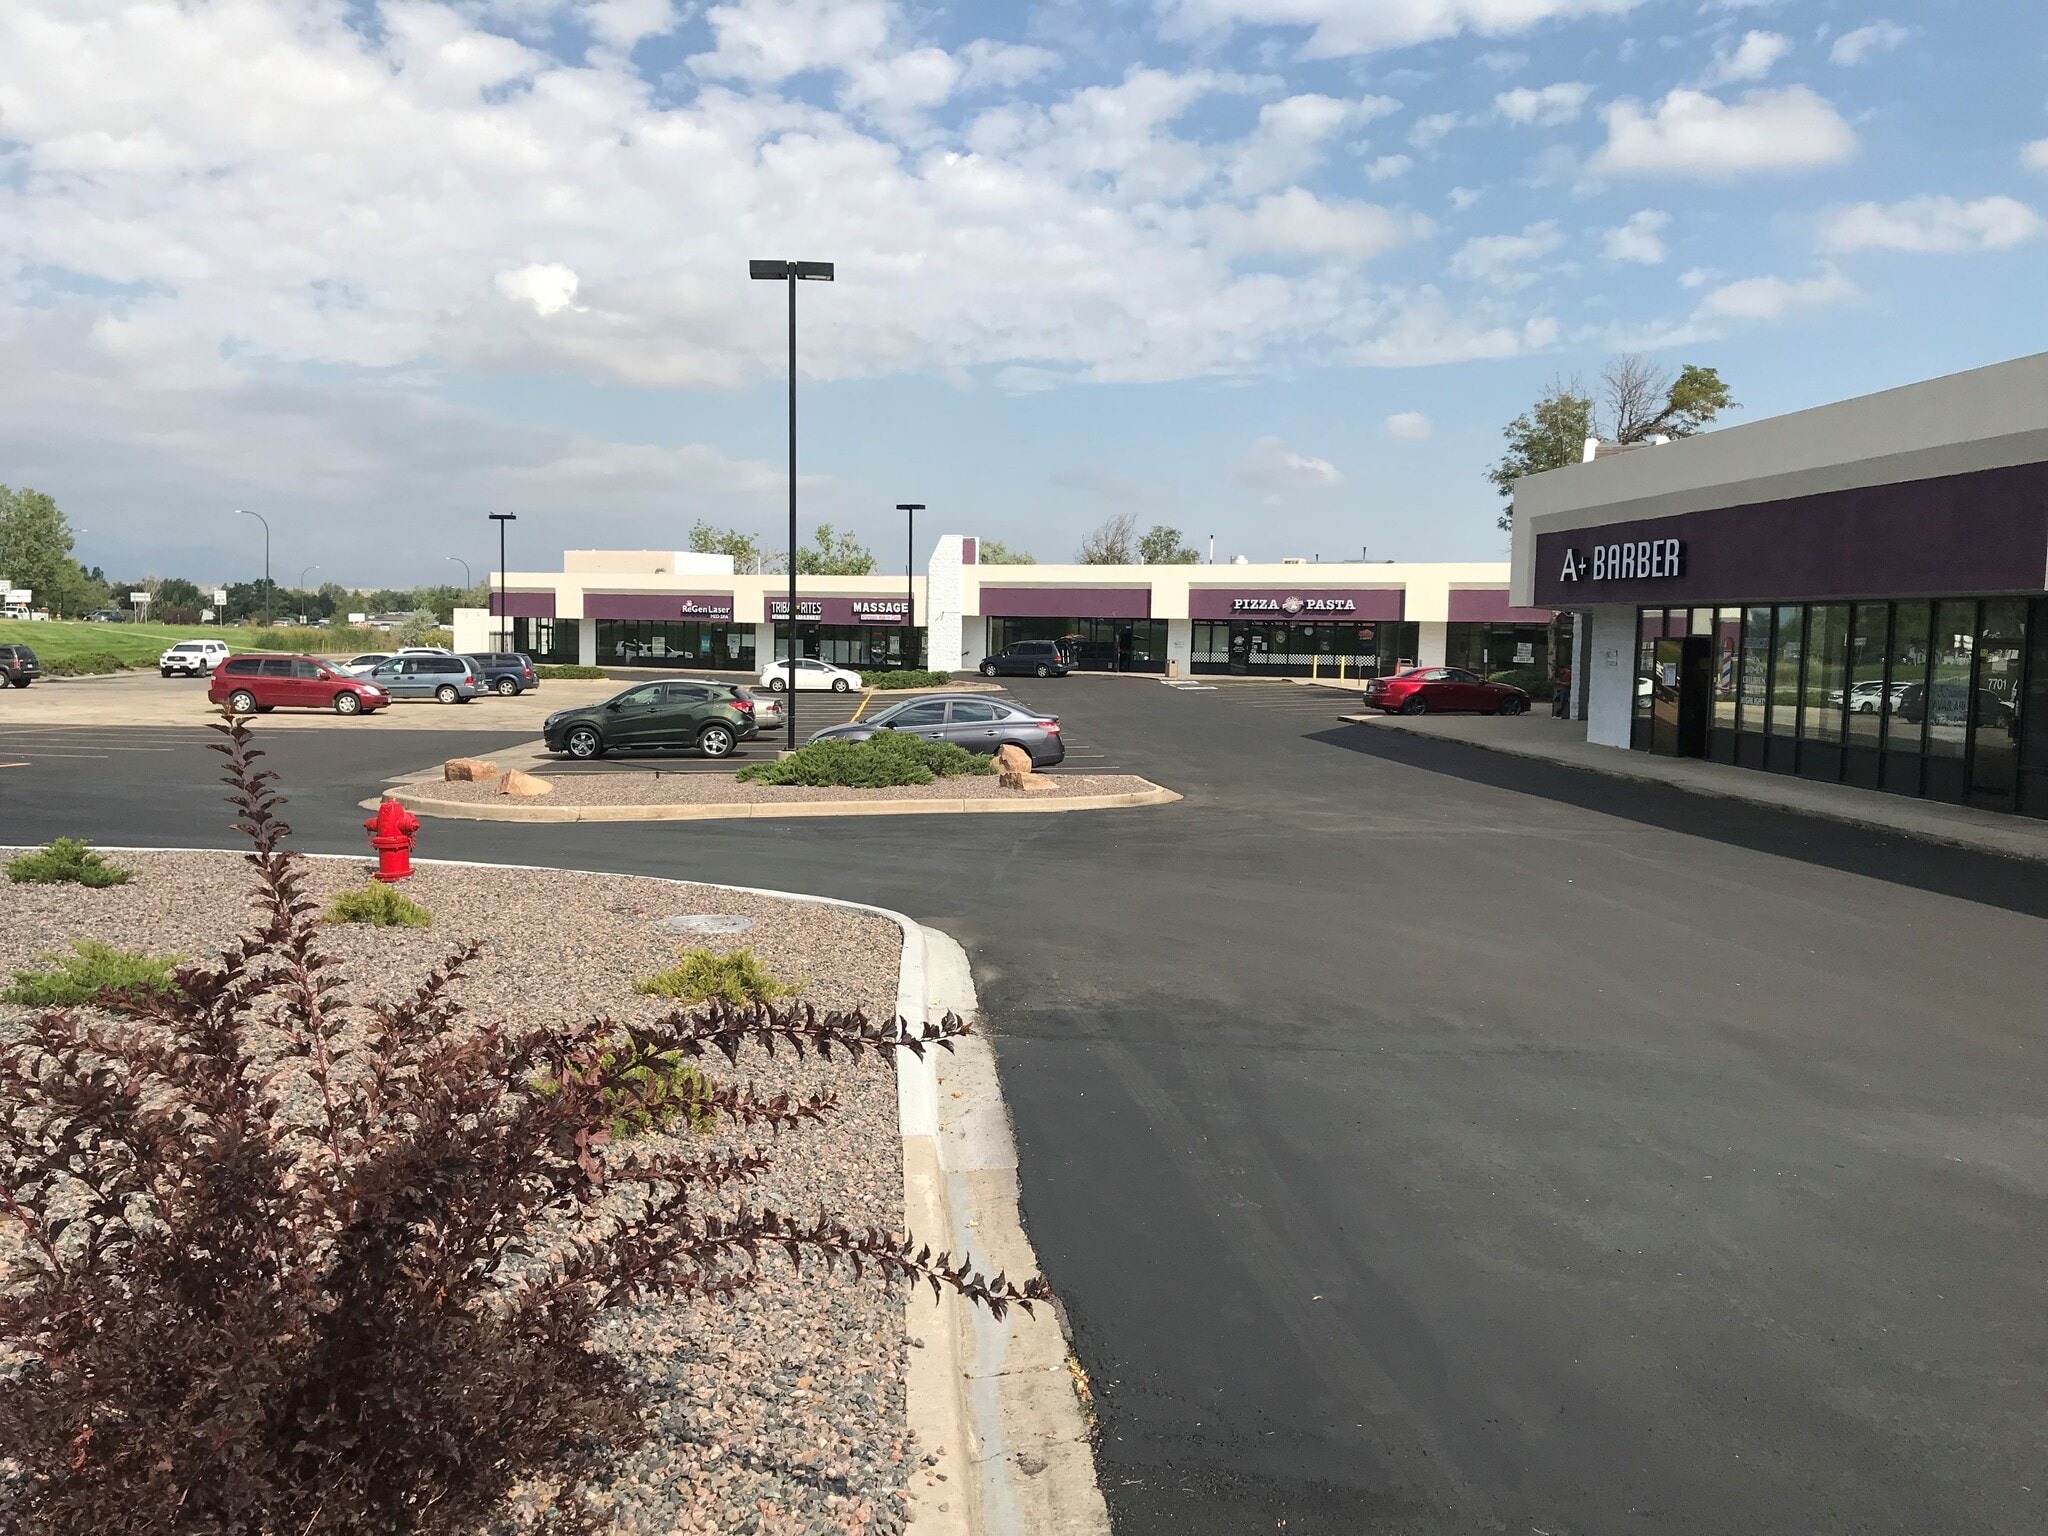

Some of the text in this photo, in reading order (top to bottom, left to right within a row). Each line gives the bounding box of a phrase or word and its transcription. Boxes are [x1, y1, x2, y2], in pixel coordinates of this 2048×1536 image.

[1560, 538, 1680, 581] A+ BARBER
[800, 601, 821, 614] RITES
[853, 602, 909, 613] MASSAGE
[1233, 599, 1356, 610] PIZZA PASTA
[1988, 678, 2007, 690] 7701
[1741, 697, 1766, 705] HIGHLIGHT
